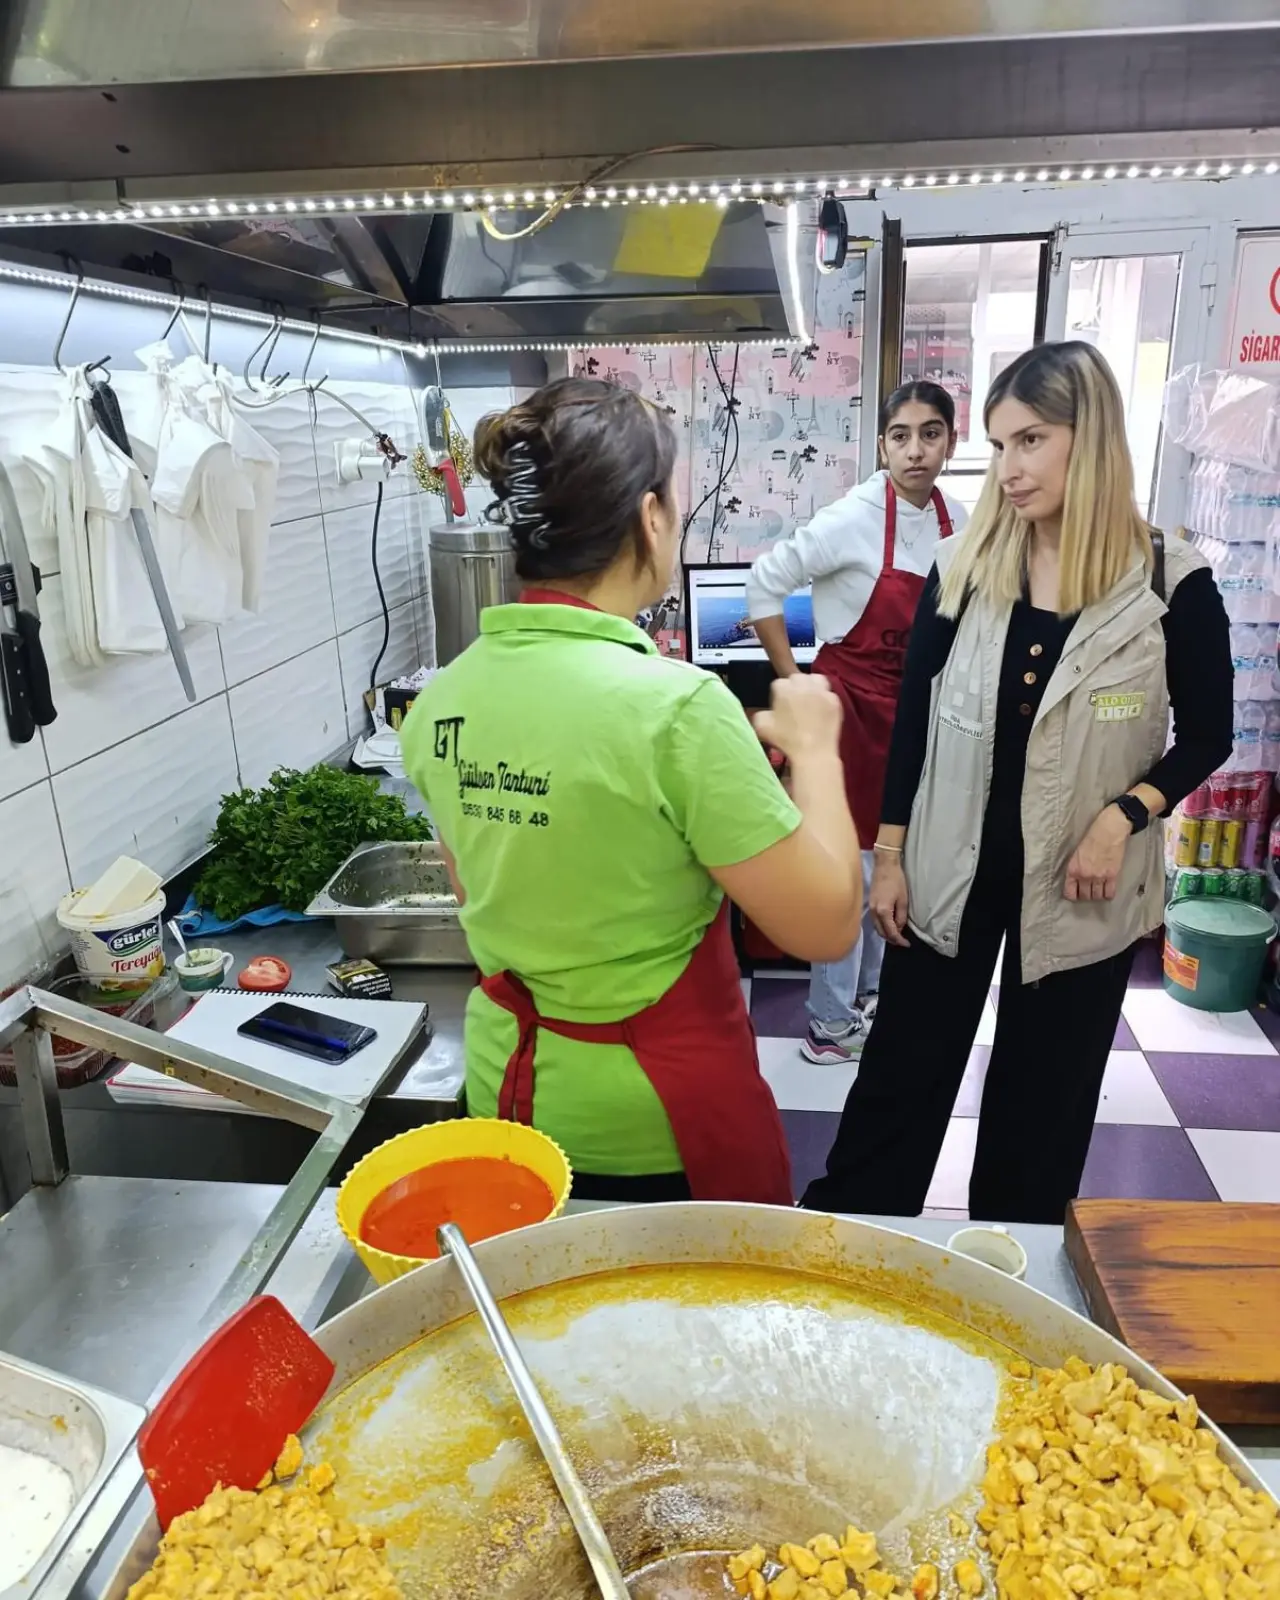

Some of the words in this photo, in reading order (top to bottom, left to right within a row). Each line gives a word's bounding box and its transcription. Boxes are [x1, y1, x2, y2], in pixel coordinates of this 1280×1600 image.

[1240, 329, 1280, 362] SİGAR
[487, 806, 505, 822] 845
[528, 812, 549, 827] 48
[112, 924, 158, 950] gürler
